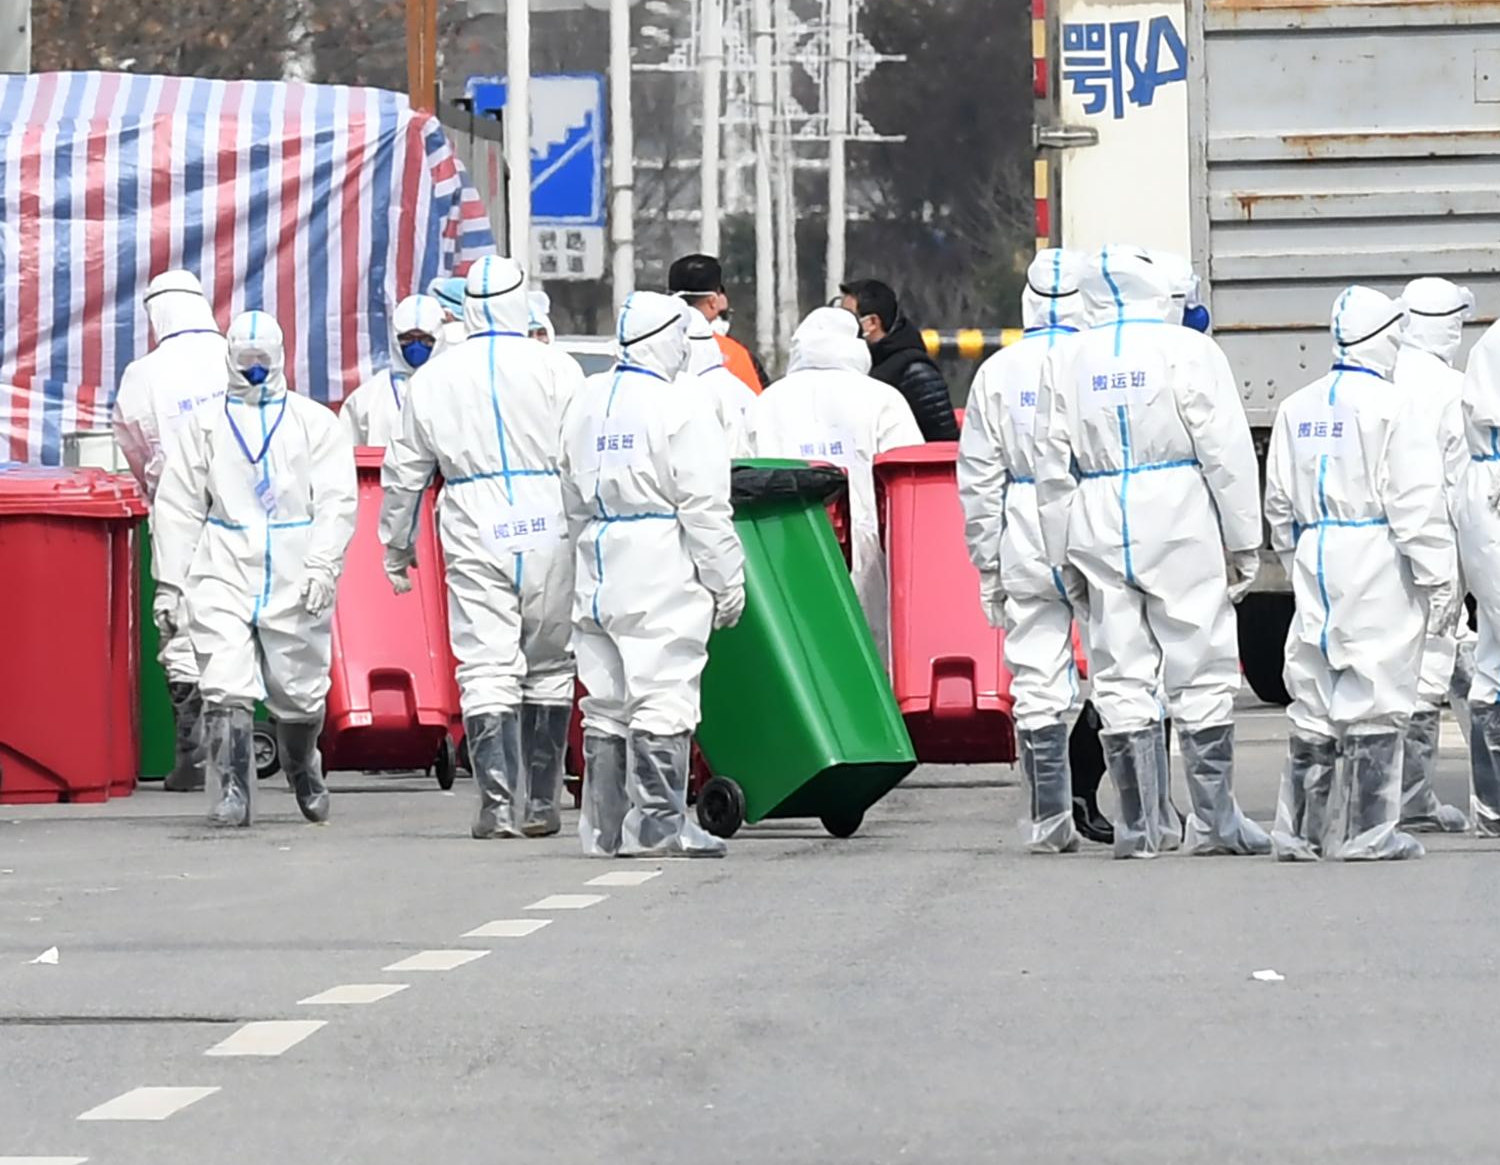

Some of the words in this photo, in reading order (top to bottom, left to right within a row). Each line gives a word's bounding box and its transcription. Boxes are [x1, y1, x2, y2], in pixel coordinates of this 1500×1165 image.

[1091, 371, 1146, 392] 搬运班
[493, 518, 546, 539] 搬运班
